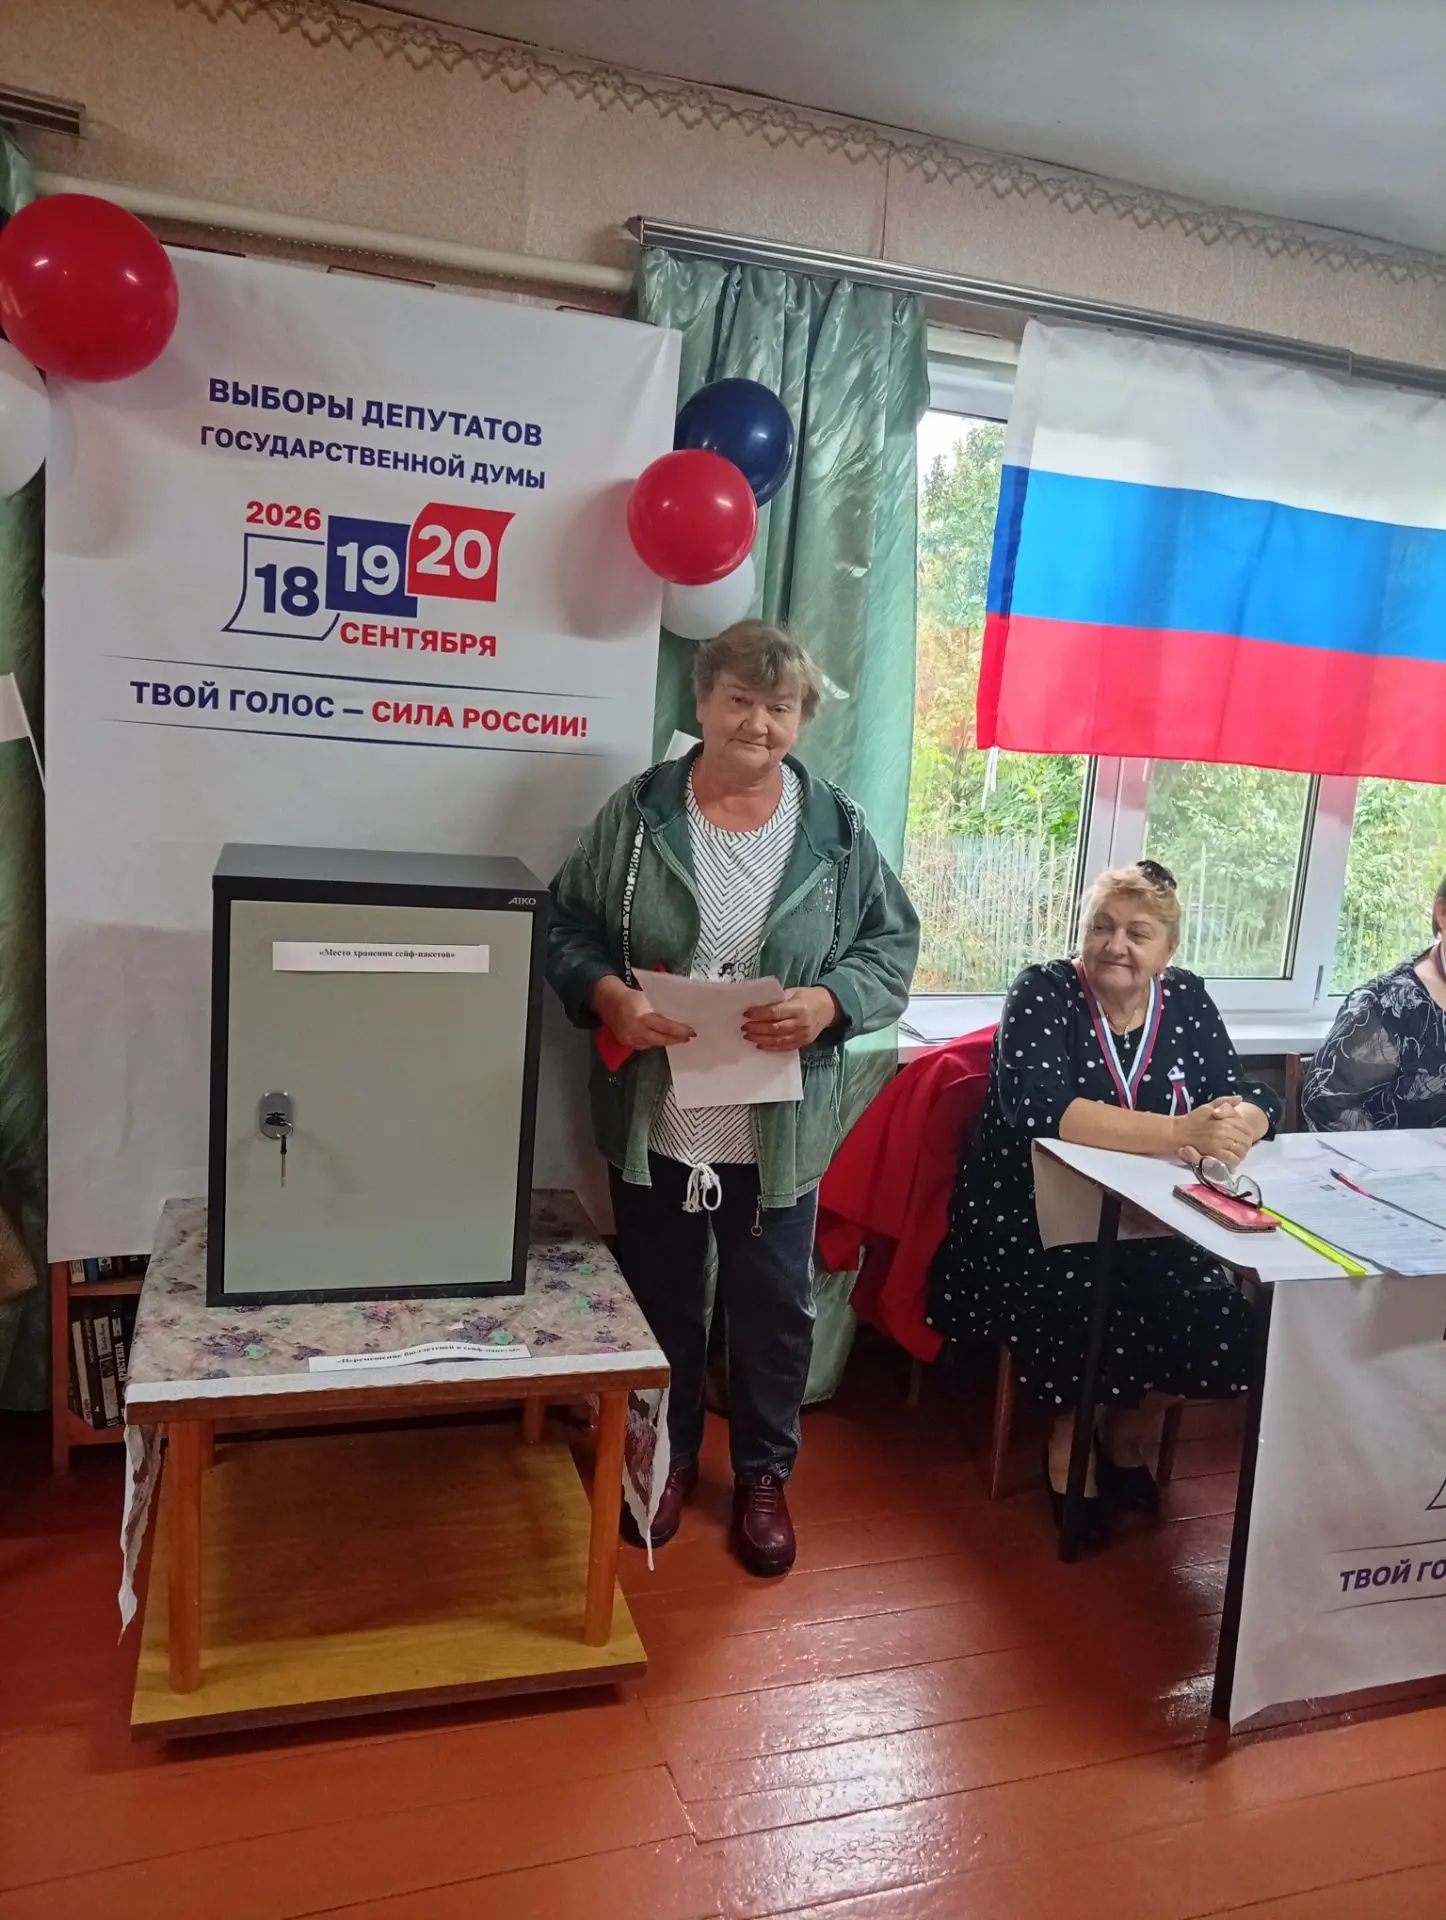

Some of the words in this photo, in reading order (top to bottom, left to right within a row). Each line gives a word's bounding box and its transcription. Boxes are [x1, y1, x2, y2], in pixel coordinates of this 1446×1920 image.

[208, 378, 354, 421] ВЫБОРЫ
[361, 400, 544, 447] ДЕПУТАТОВ
[200, 426, 465, 478] ГОСУДАРСТВЕННОЙ
[470, 461, 546, 490] ДУМЫ
[245, 501, 322, 531] 2026
[253, 563, 320, 617] 18
[336, 542, 401, 596] 19
[416, 524, 492, 579] 20
[339, 622, 497, 657] СЕНТЯБРЯ
[130, 681, 220, 711] ТВОЙ
[228, 688, 334, 718] ГОЛОС
[371, 700, 454, 728] СИЛА
[462, 709, 588, 738] РОССИИ!
[508, 897, 537, 906] AIKO
[1339, 1558, 1412, 1592] ТВОЙ
